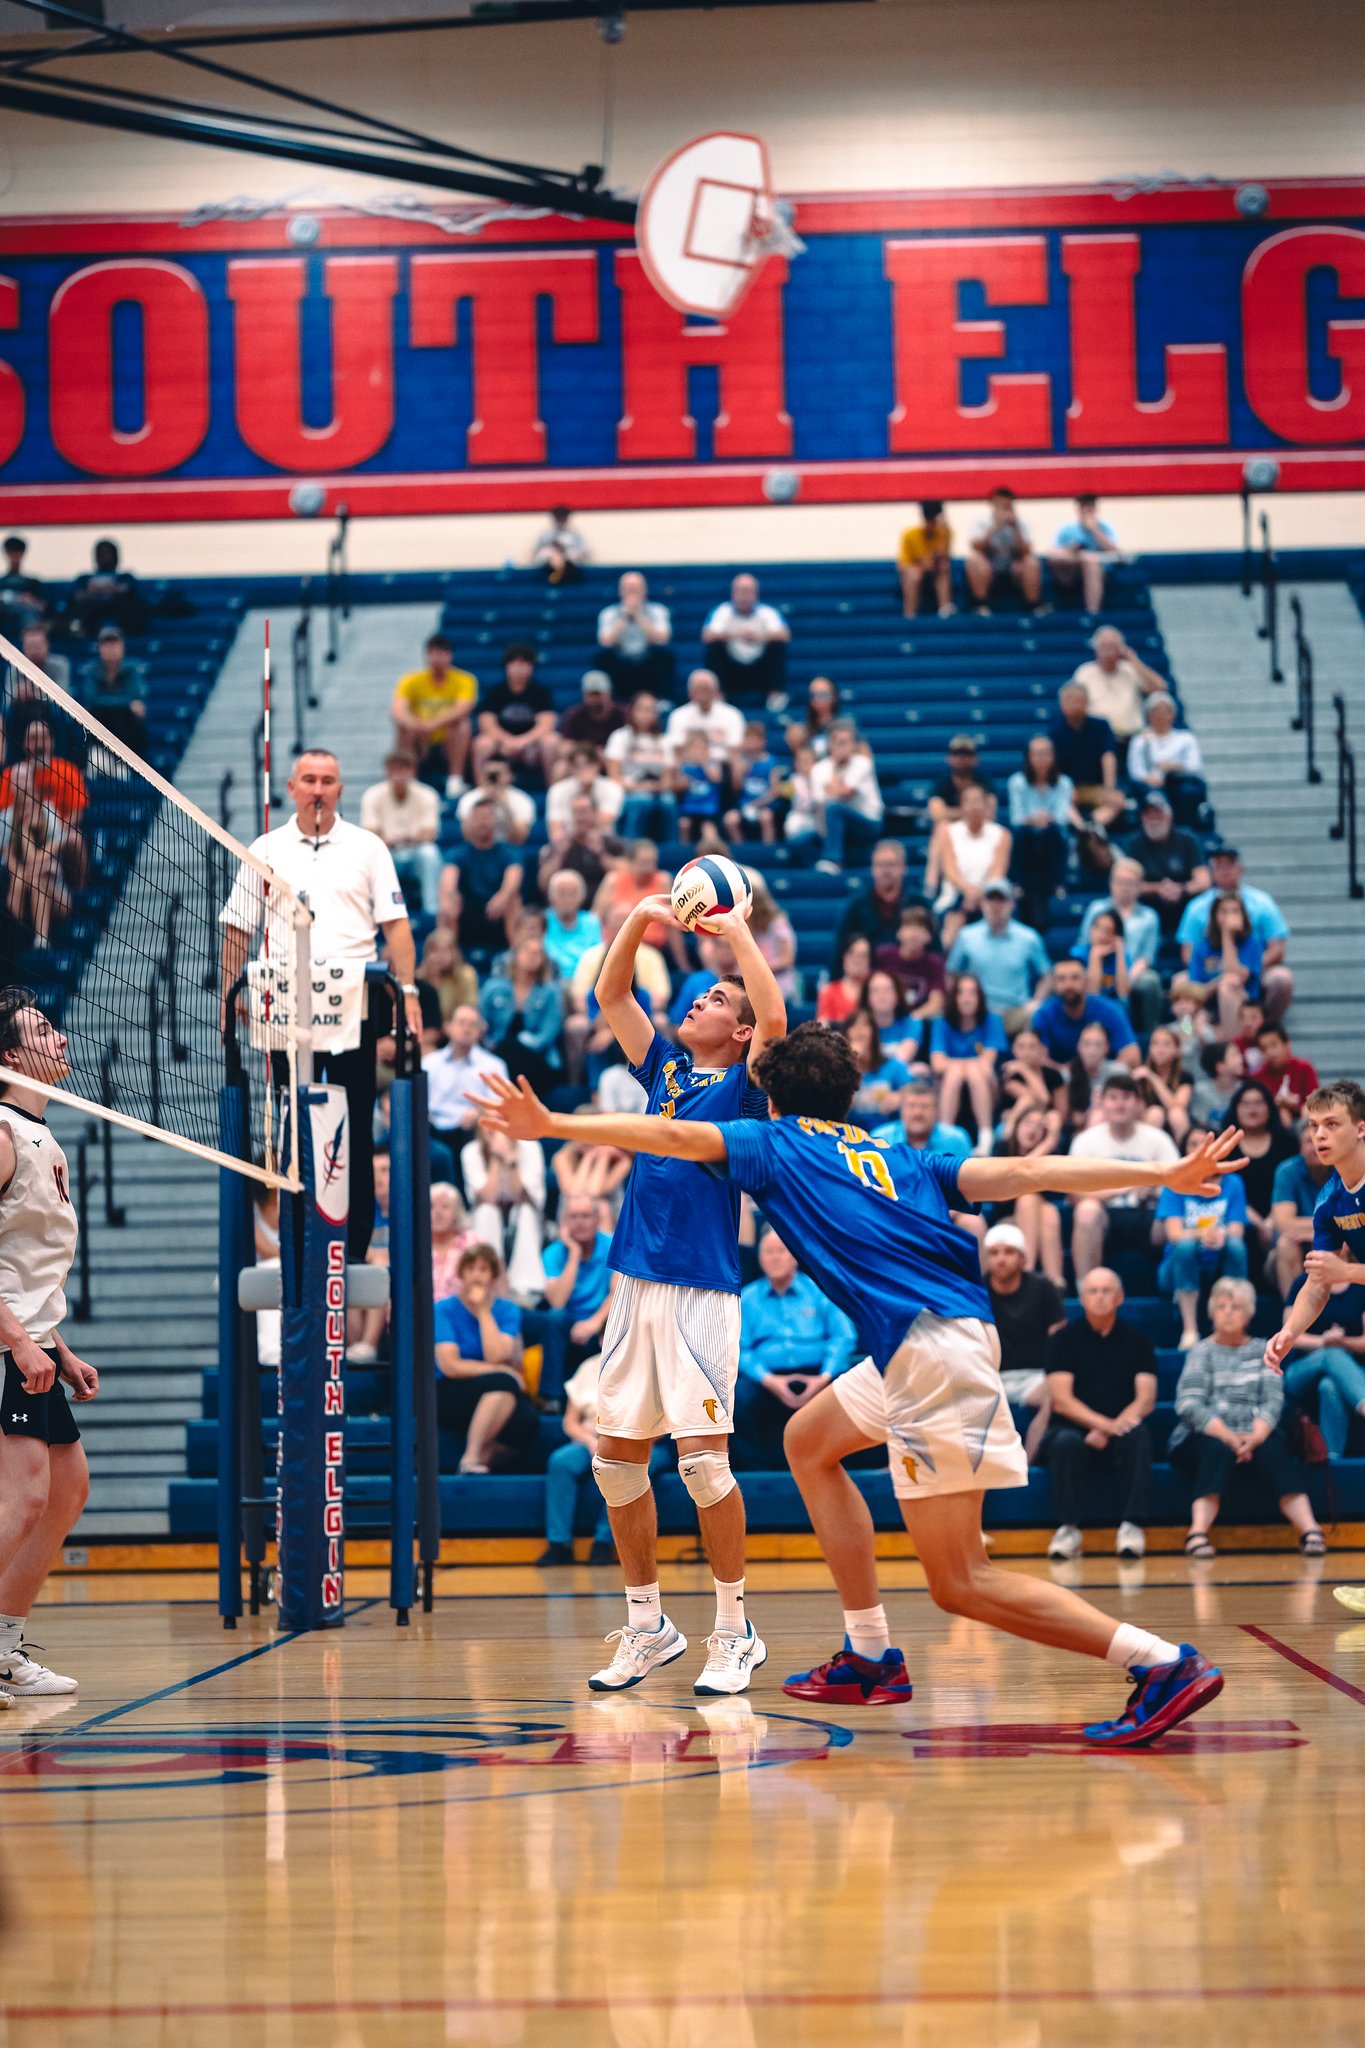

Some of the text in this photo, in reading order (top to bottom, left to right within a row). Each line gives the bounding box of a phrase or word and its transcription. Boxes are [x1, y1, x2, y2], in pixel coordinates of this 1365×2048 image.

[0, 250, 793, 476] OUTH
[322, 1240, 345, 1608] SOUTH ELGIN
